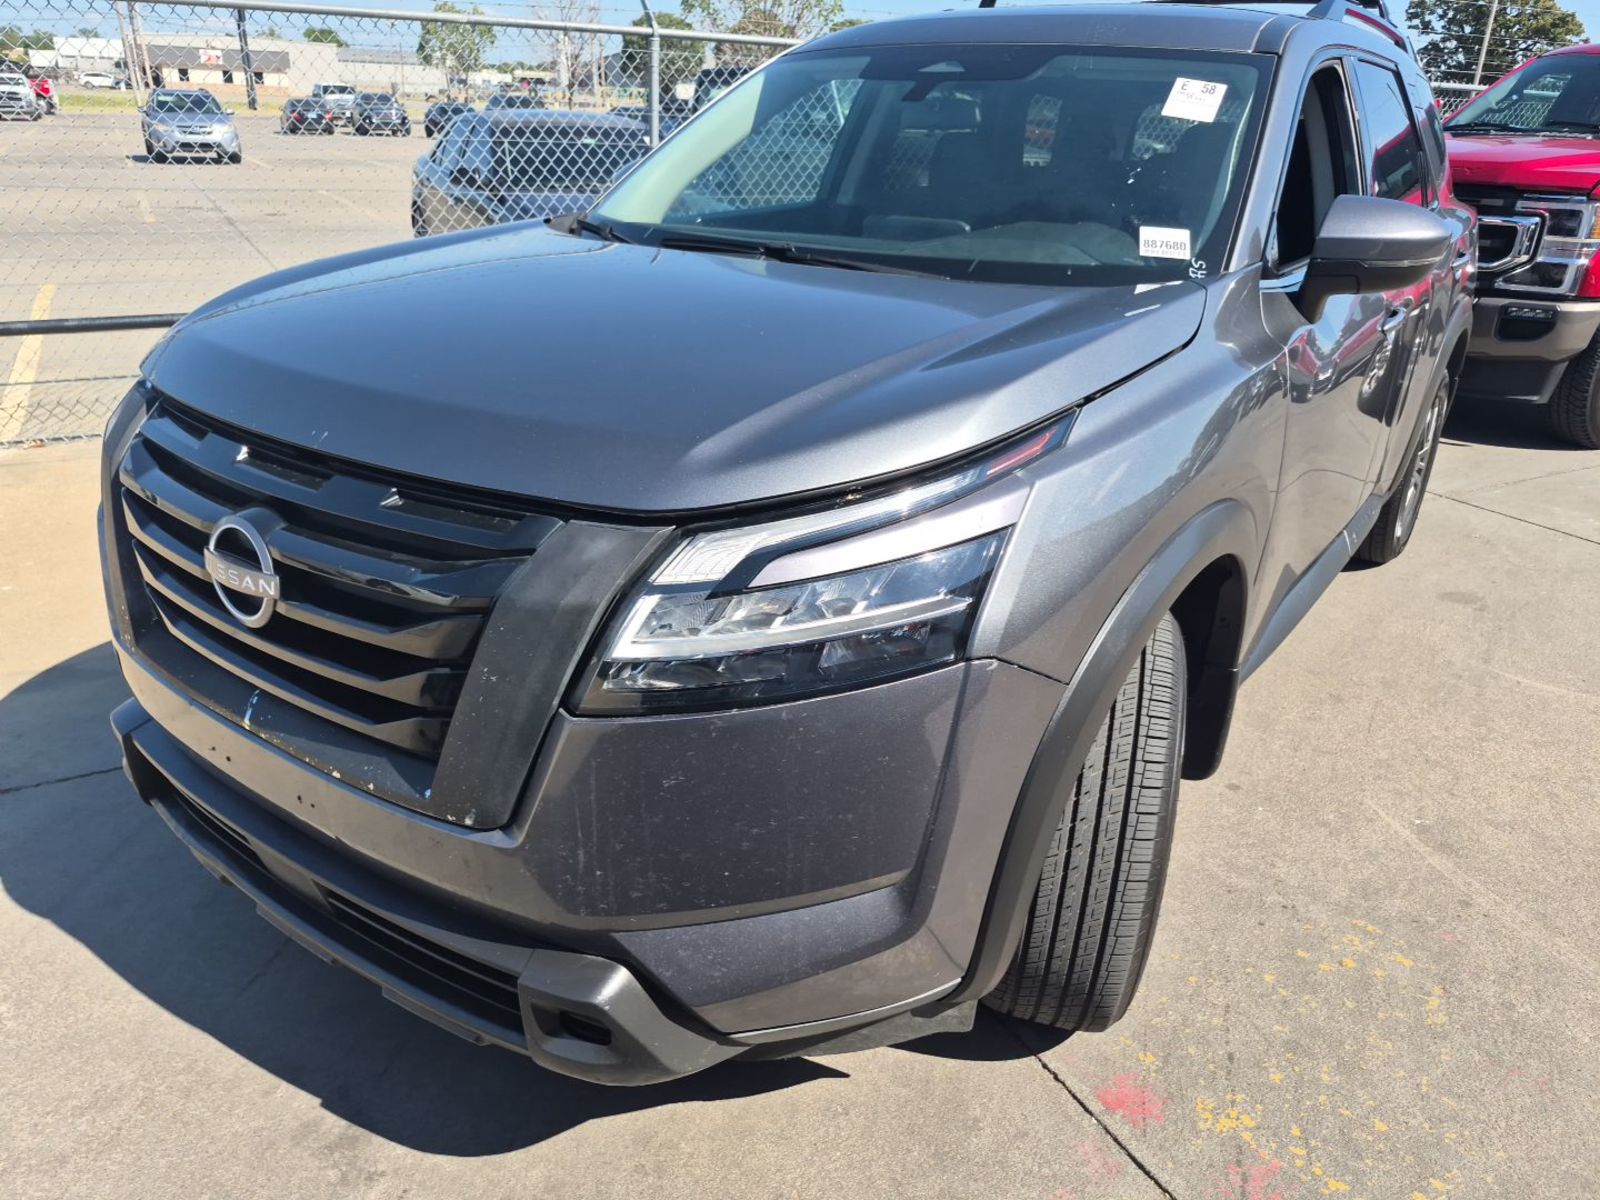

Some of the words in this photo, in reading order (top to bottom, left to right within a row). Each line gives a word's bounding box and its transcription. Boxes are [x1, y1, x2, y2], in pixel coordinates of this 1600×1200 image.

[1201, 84, 1217, 95] 58
[1143, 239, 1187, 251] 887680
[207, 557, 275, 596] SSAN
